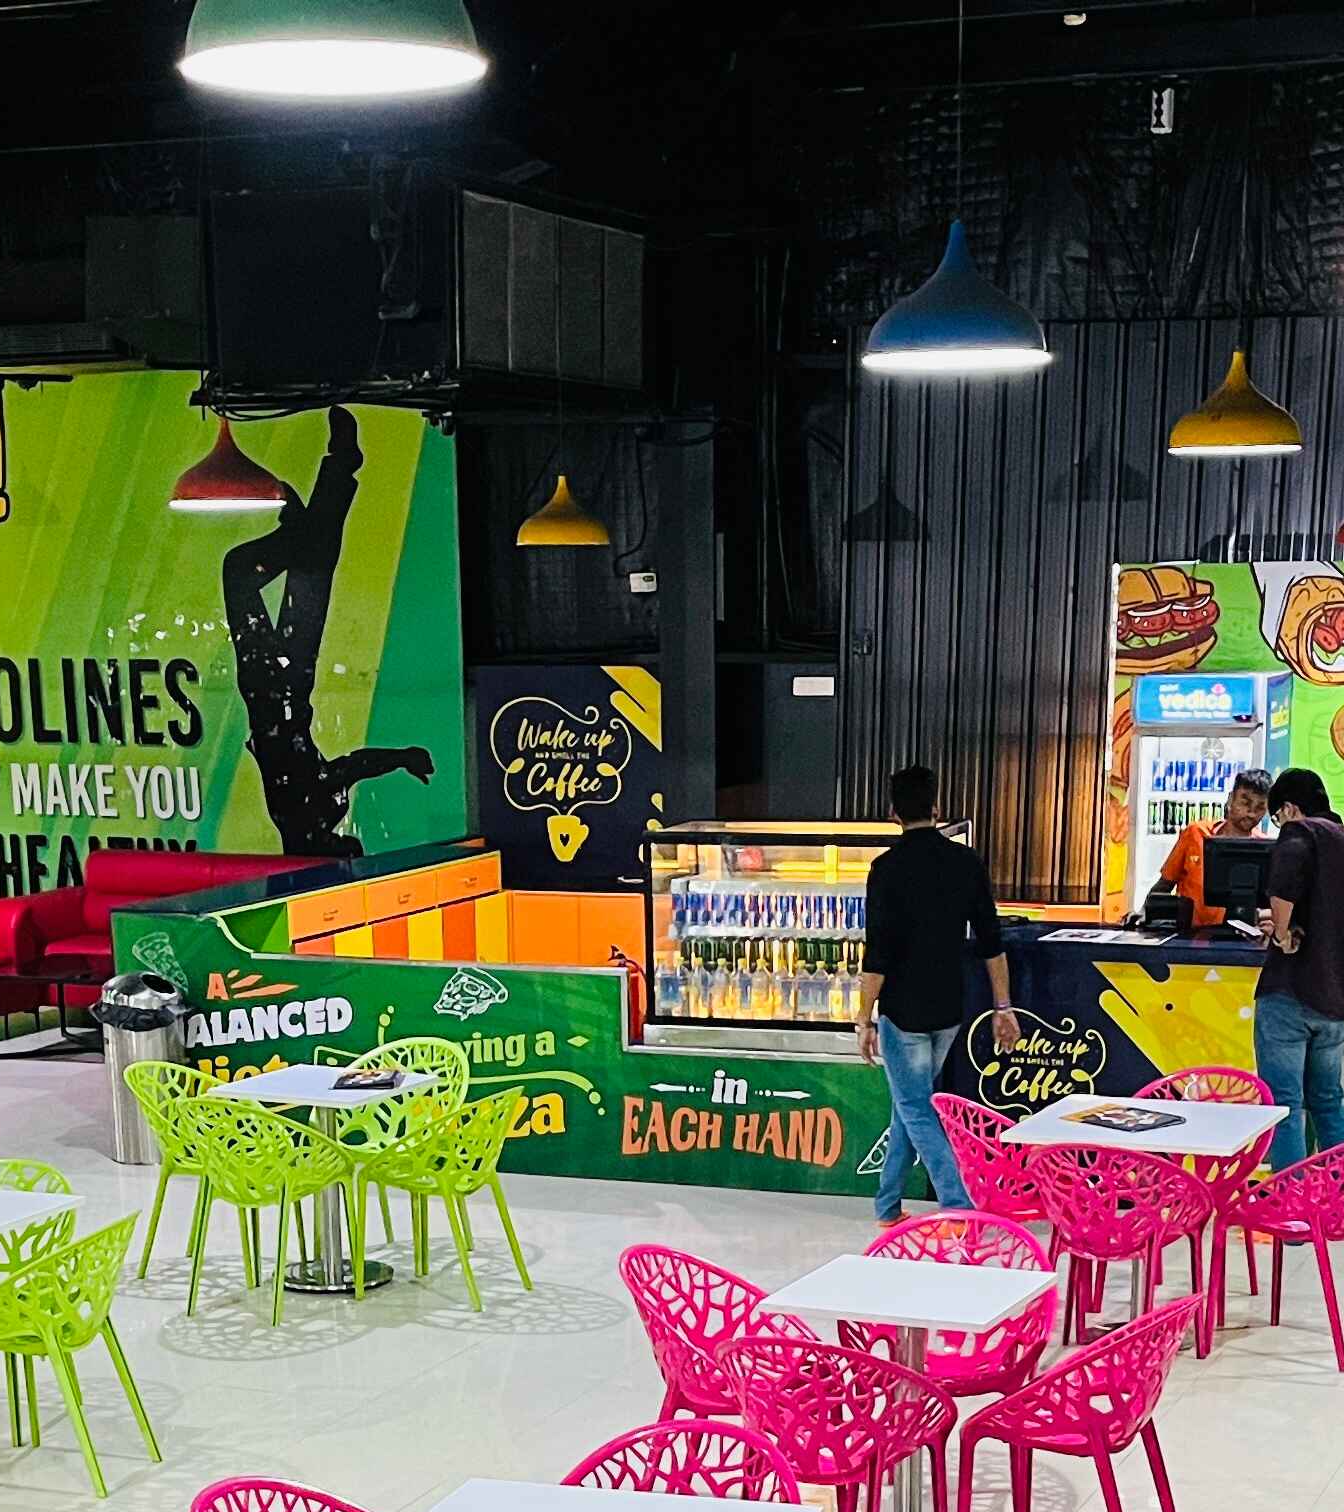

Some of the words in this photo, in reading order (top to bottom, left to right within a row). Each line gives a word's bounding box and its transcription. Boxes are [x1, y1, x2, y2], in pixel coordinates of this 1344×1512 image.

[517, 718, 581, 751] Wake
[584, 729, 616, 757] up
[10, 762, 118, 818] MAKE
[124, 764, 204, 821] YOU
[526, 762, 603, 801] Coffee
[207, 973, 230, 1000] A
[186, 997, 353, 1048] ALANCED
[535, 1030, 556, 1057] a
[1058, 1039, 1090, 1064] up
[711, 1069, 748, 1105] in
[1001, 1066, 1075, 1102] Coffee
[622, 1095, 723, 1155] EACH
[732, 1107, 843, 1168] HAND
